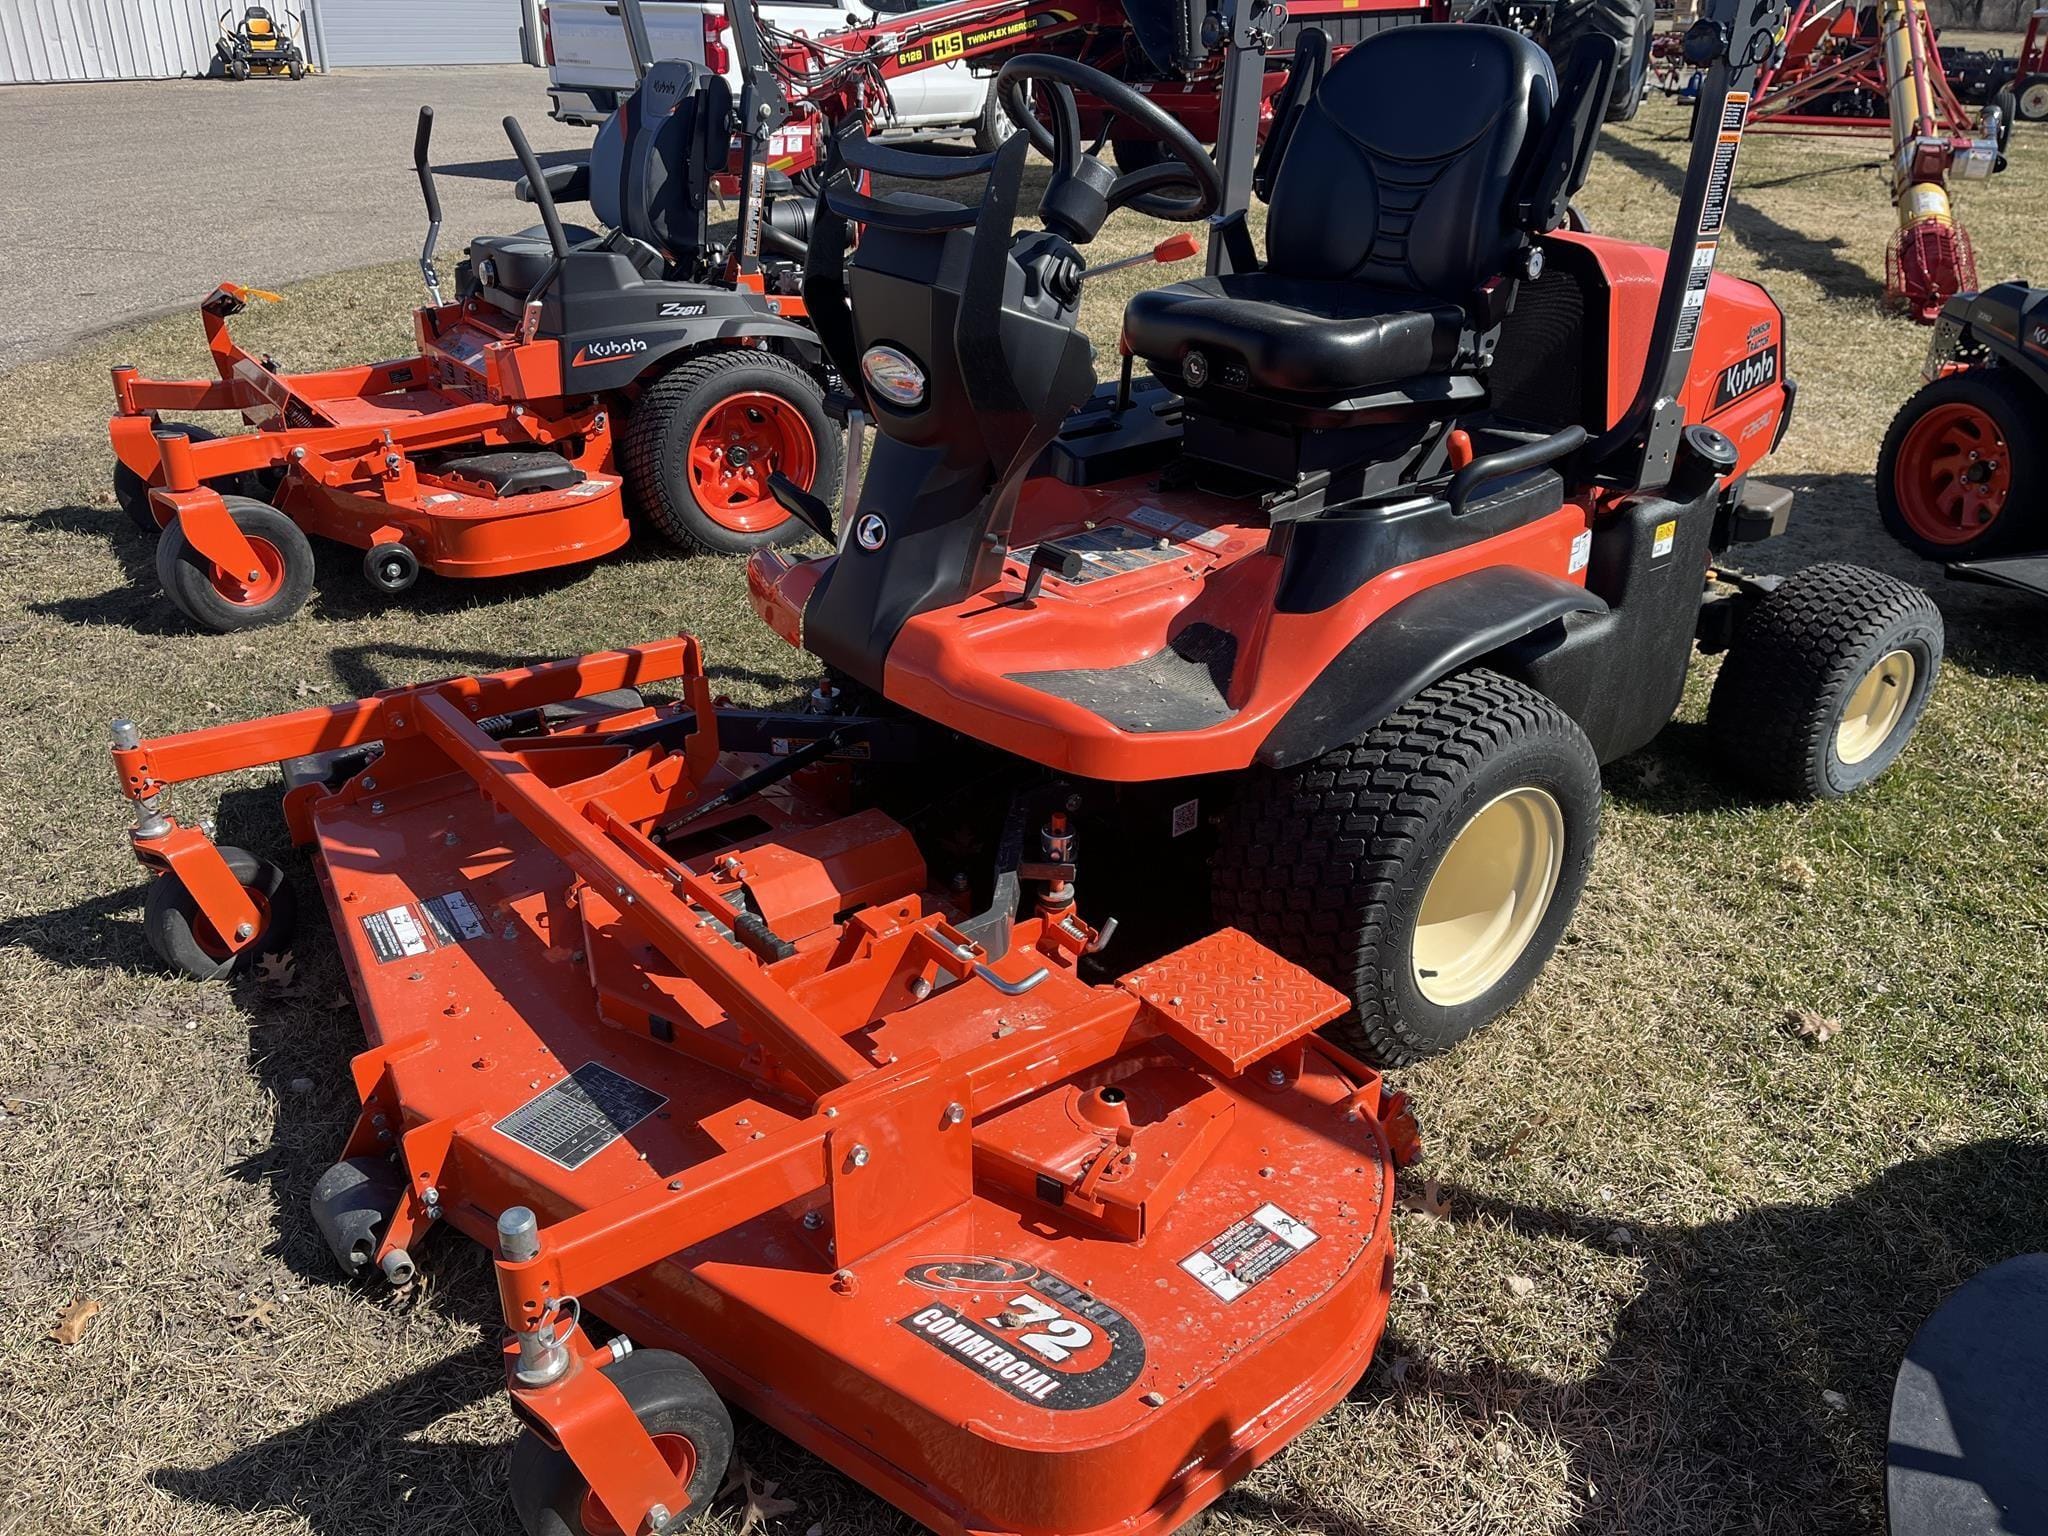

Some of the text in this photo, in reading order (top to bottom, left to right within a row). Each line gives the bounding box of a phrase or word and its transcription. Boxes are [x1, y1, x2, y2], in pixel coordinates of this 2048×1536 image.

[899, 50, 923, 65] 6128
[967, 28, 1007, 46] TWIN-FLEX
[1007, 19, 1038, 35] MERGER
[653, 80, 676, 95] Kubota
[660, 302, 706, 316] Z781i
[588, 338, 647, 356] Kubota
[1726, 350, 1774, 397] Kubota
[1219, 1220, 1249, 1243] DANGER
[1239, 1238, 1274, 1263] PELIGRO
[984, 1293, 1093, 1362] 72
[912, 1308, 1061, 1400] COMMERCIAL
